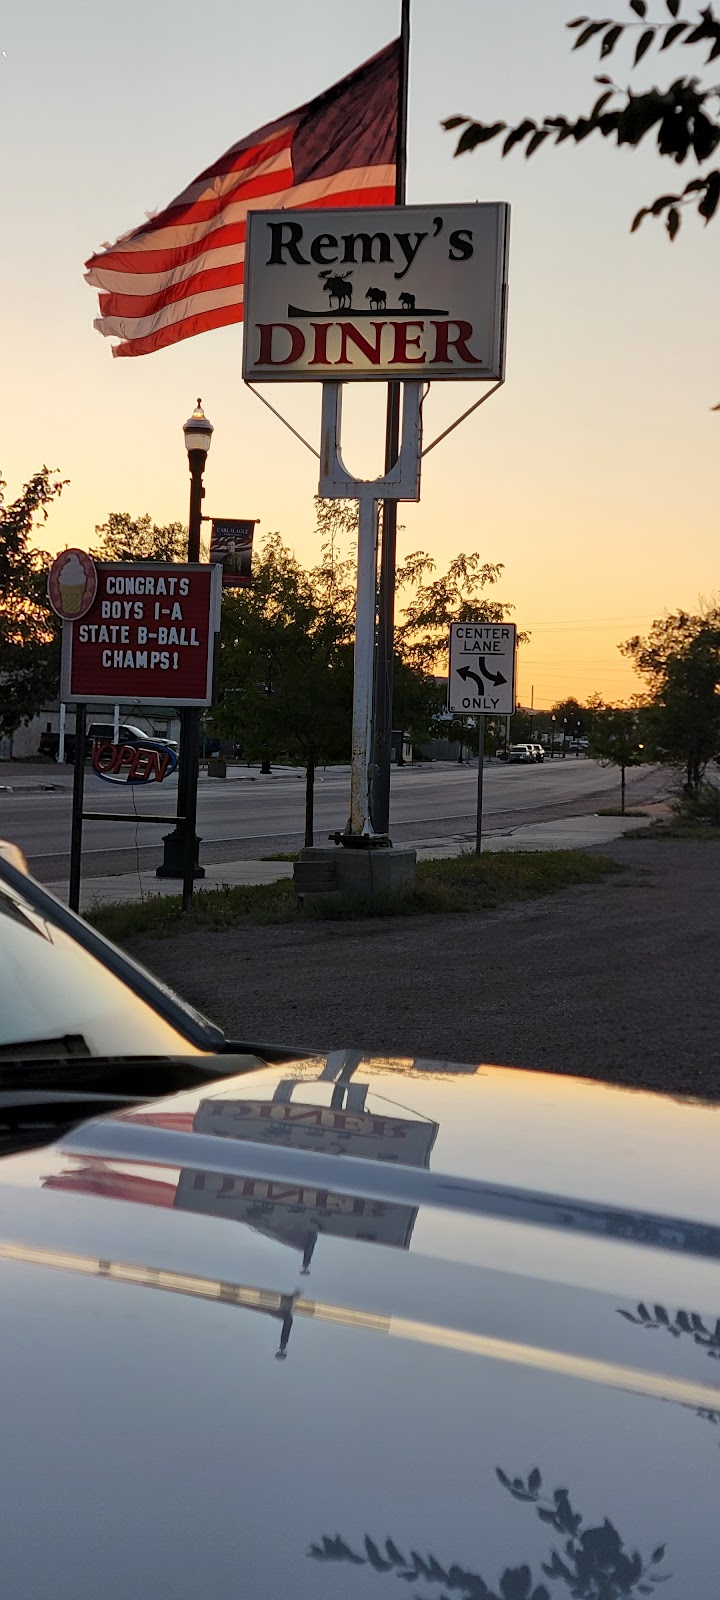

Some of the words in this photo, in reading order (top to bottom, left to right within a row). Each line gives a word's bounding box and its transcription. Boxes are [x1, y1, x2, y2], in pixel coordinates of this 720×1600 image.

[266, 217, 475, 280] Remy's
[254, 320, 483, 366] DINER
[106, 576, 190, 596] CONGRATS
[101, 601, 144, 620] BOYS
[79, 624, 130, 644] STATE
[137, 627, 200, 647] B-BALL
[456, 627, 510, 640] CENTER
[463, 640, 501, 652] LANE
[102, 649, 180, 670] CHAMPS!
[462, 697, 500, 709] ONLY
[92, 743, 170, 783] OPEN
